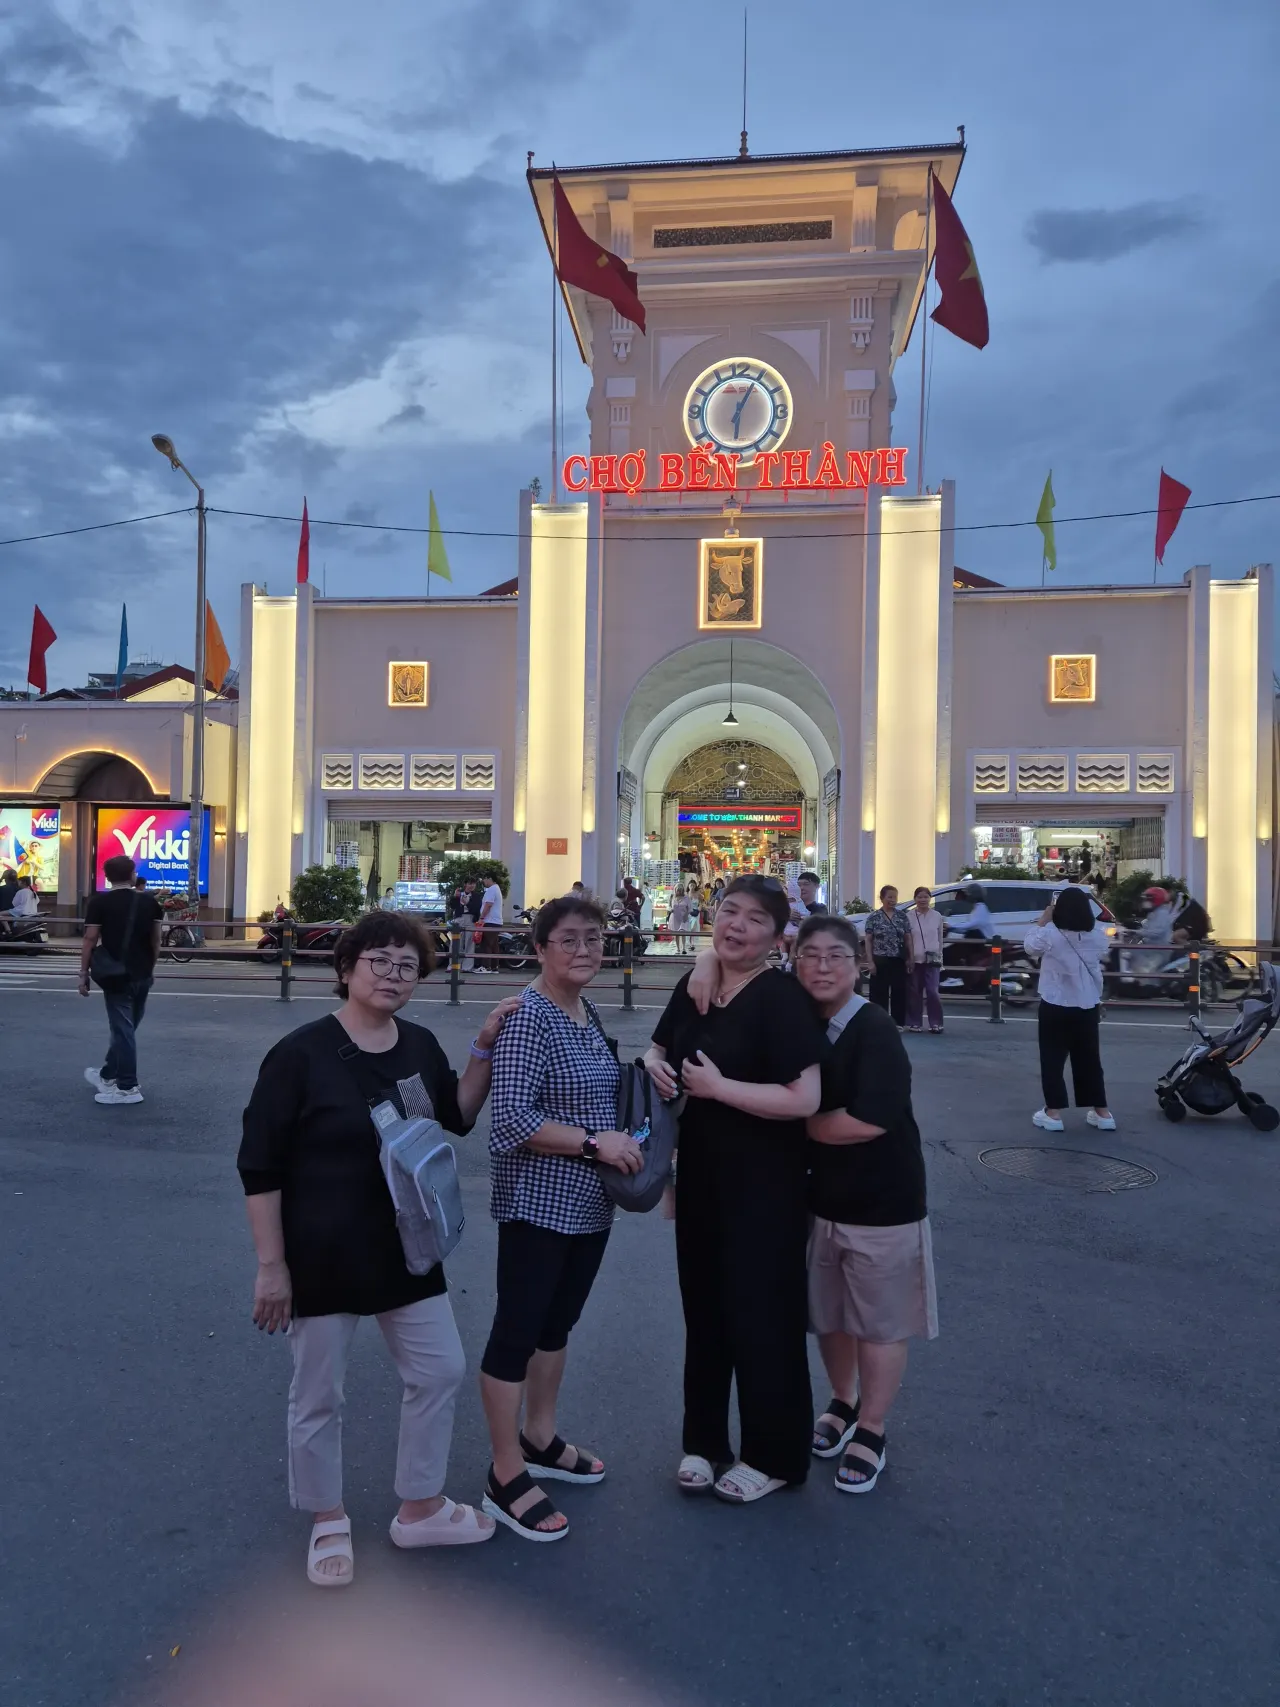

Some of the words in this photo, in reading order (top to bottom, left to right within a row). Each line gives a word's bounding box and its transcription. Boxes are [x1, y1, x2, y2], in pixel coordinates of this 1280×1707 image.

[729, 362, 750, 377] 12
[688, 404, 700, 420] 9
[563, 449, 646, 495] CHỢ
[659, 441, 741, 490] BẾN
[754, 441, 909, 488] THÀNH
[32, 812, 58, 829] Vikki
[112, 815, 190, 860] Vikki
[148, 861, 171, 870] Digital
